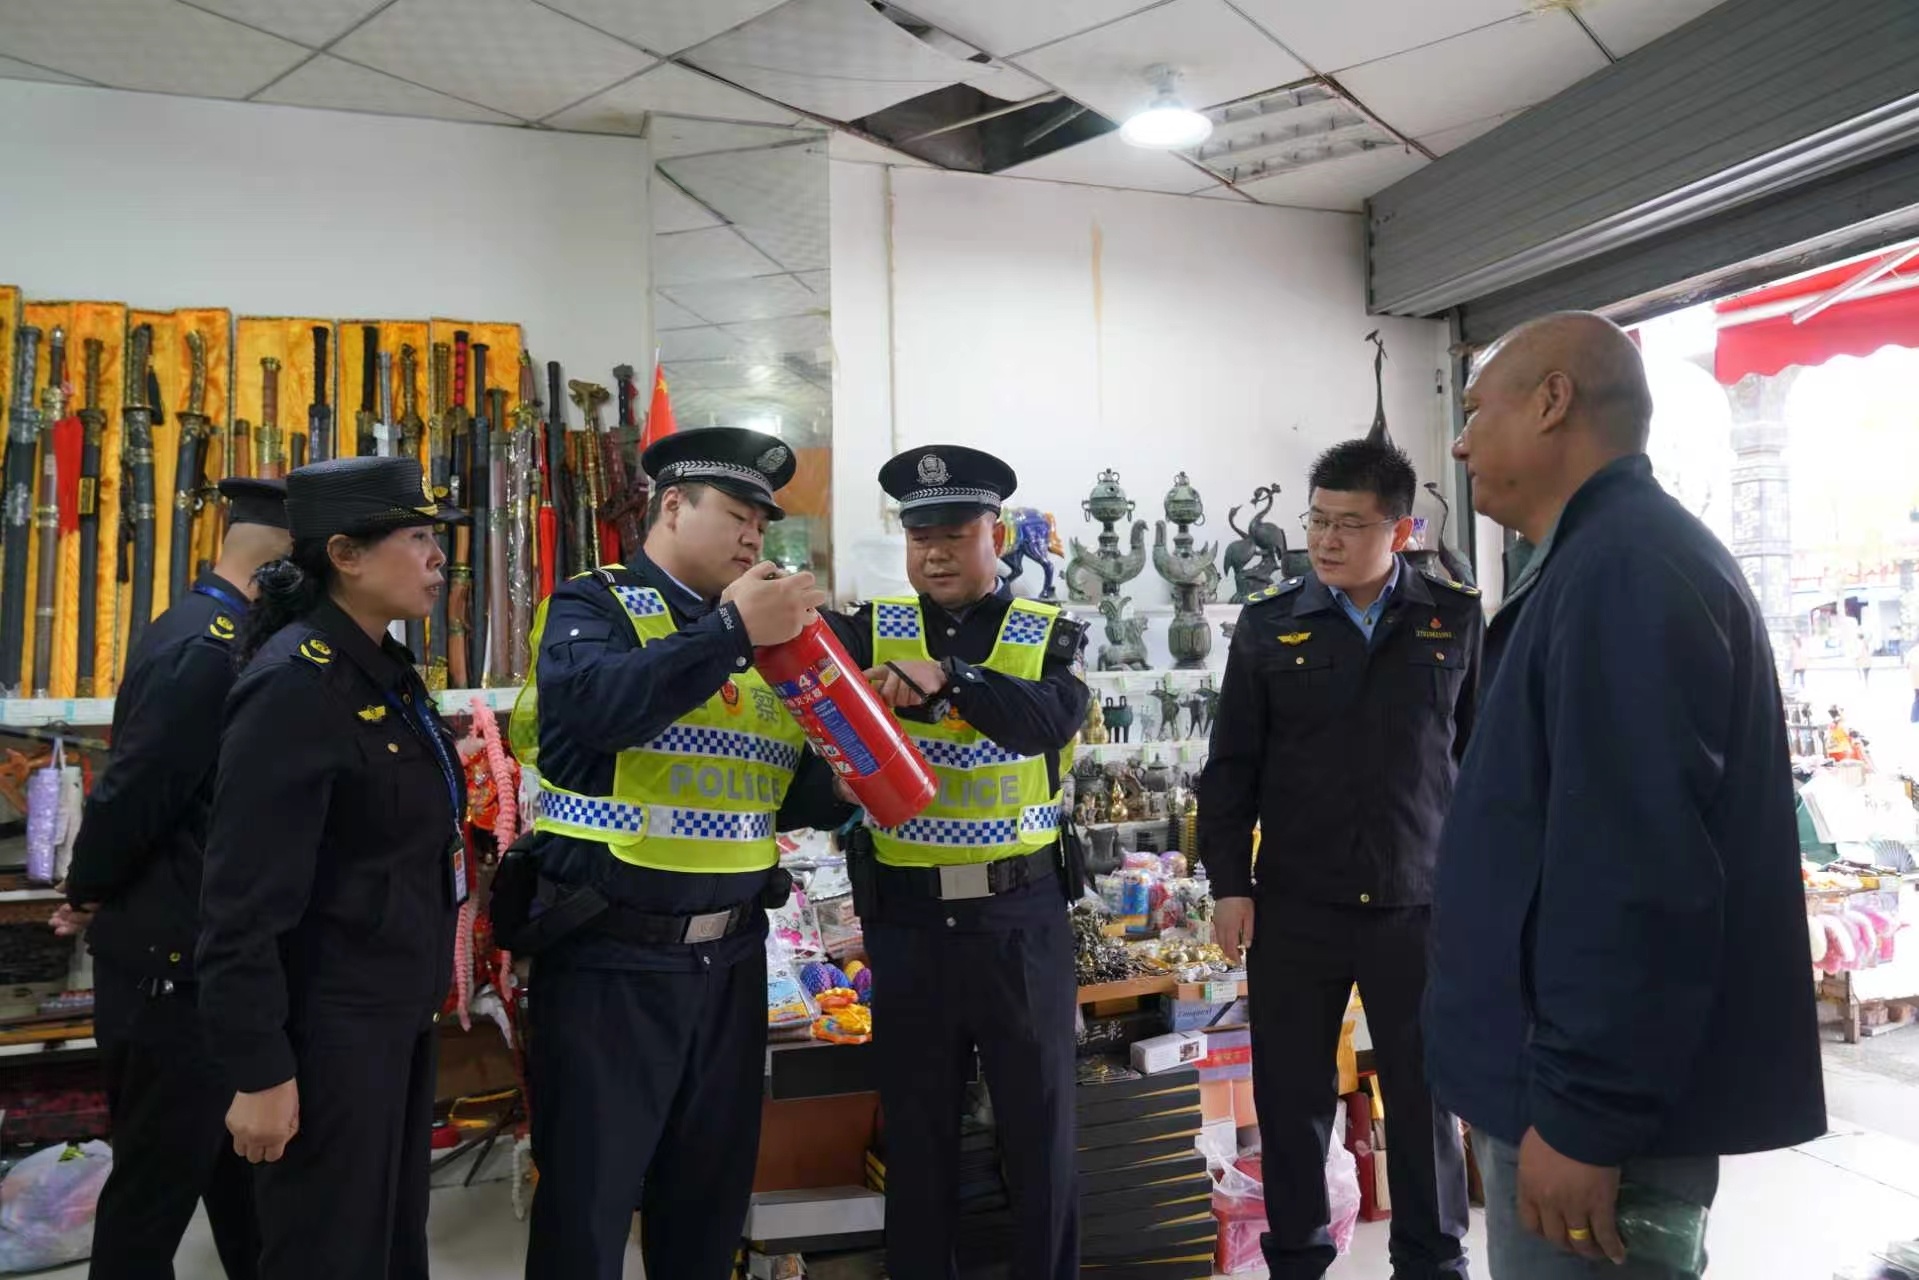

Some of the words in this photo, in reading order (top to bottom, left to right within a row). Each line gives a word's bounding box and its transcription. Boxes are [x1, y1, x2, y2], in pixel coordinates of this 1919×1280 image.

[799, 674, 811, 688] 4
[669, 764, 782, 806] POLICE
[940, 775, 1020, 808] LICE
